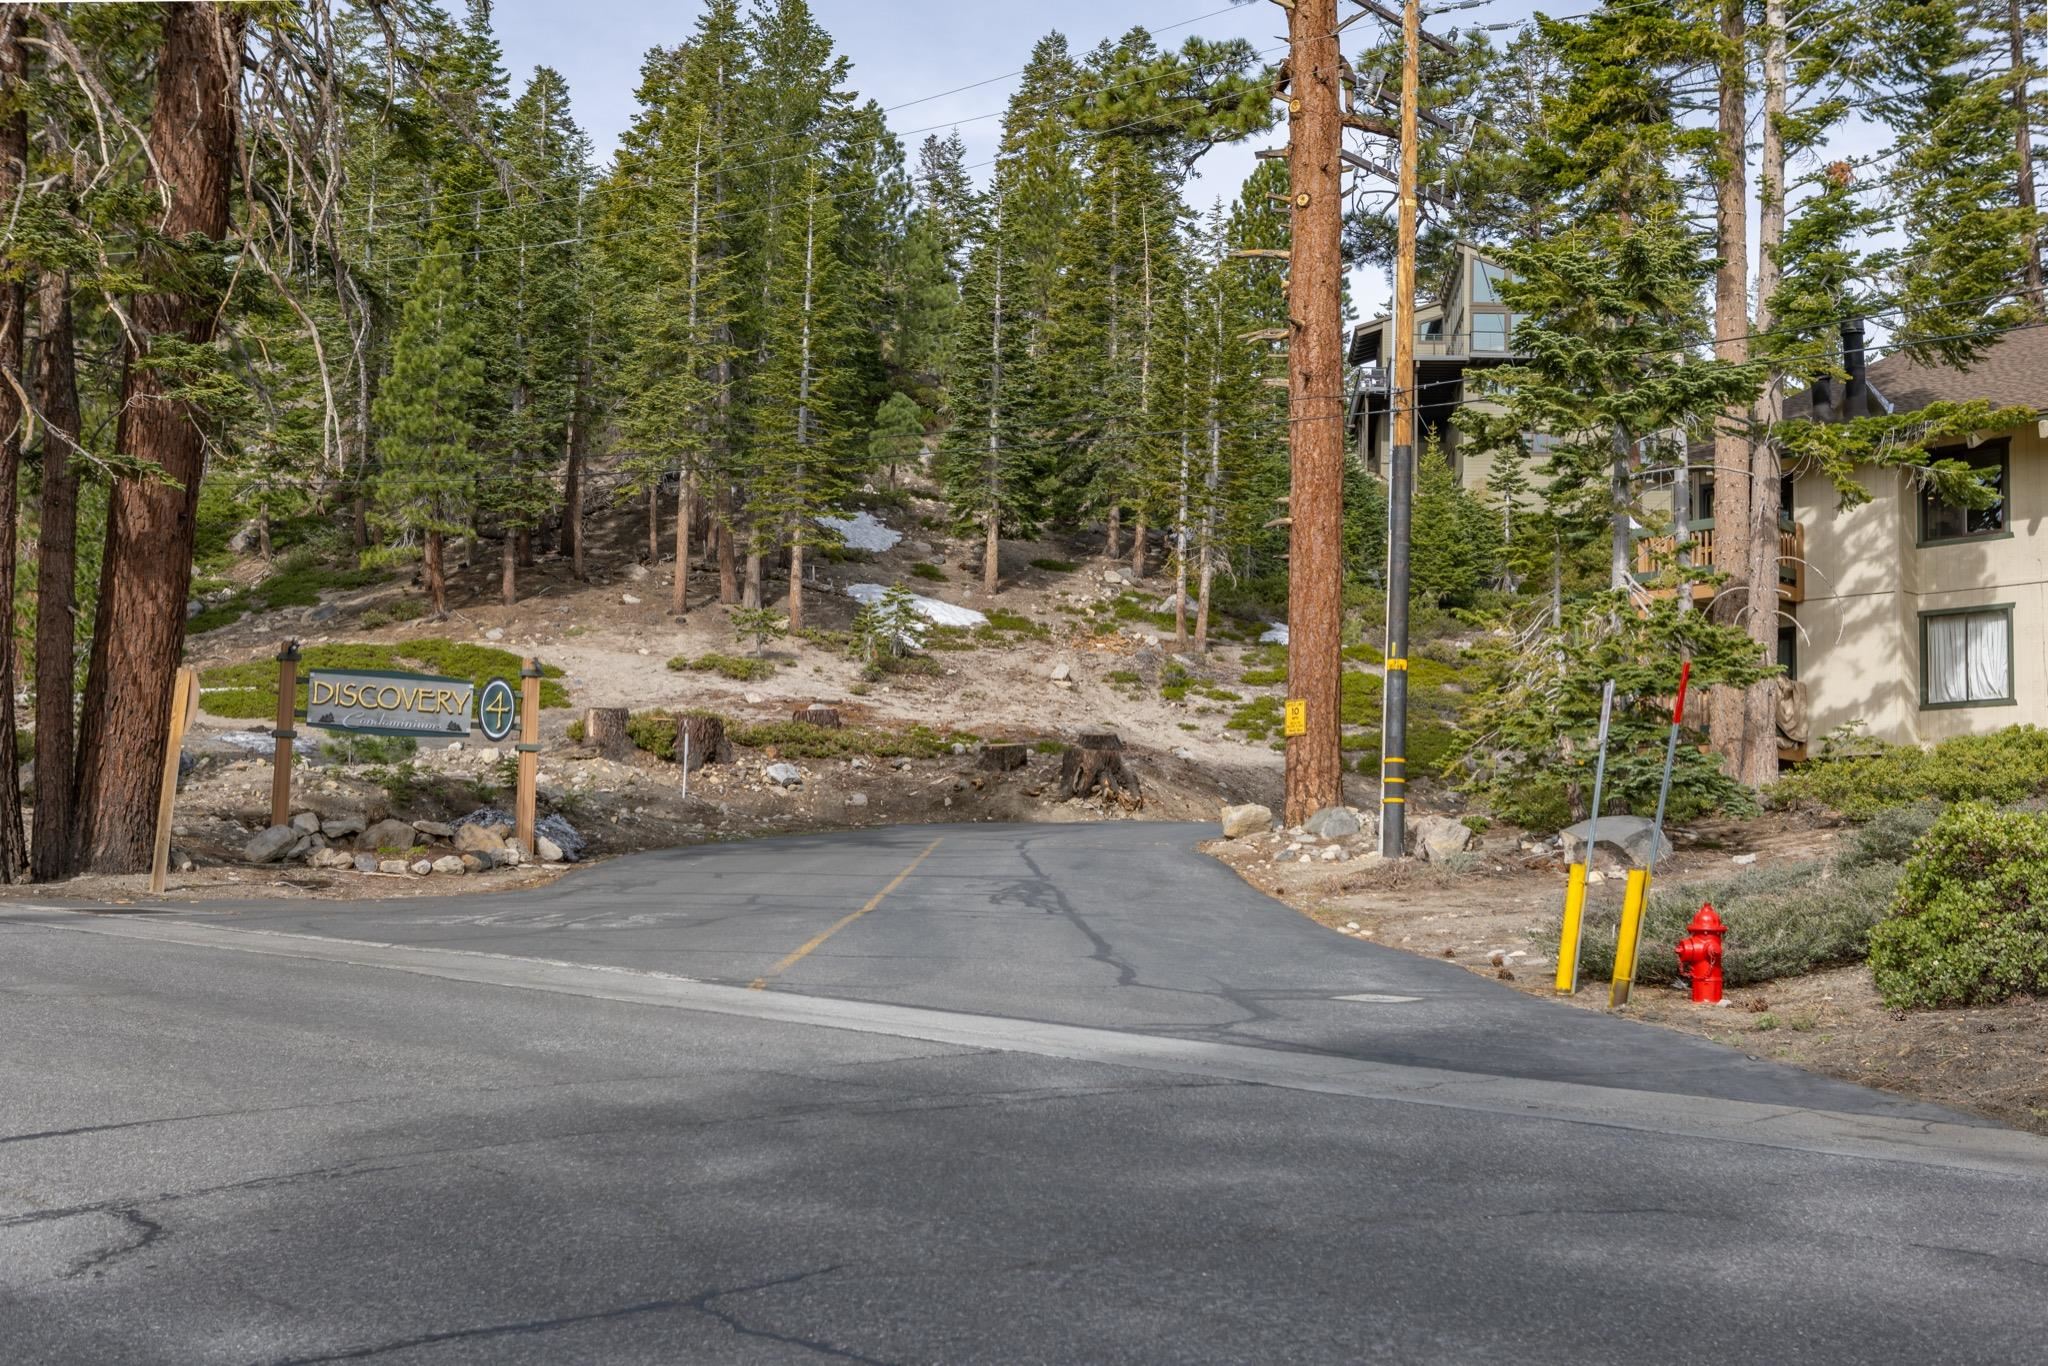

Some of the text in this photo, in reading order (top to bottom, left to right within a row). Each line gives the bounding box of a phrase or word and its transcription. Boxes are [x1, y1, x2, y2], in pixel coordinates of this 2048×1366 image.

[311, 681, 470, 715] DISCOVERY
[485, 691, 510, 729] 4
[342, 711, 442, 729] Condominiums
[1291, 707, 1299, 716] 10
